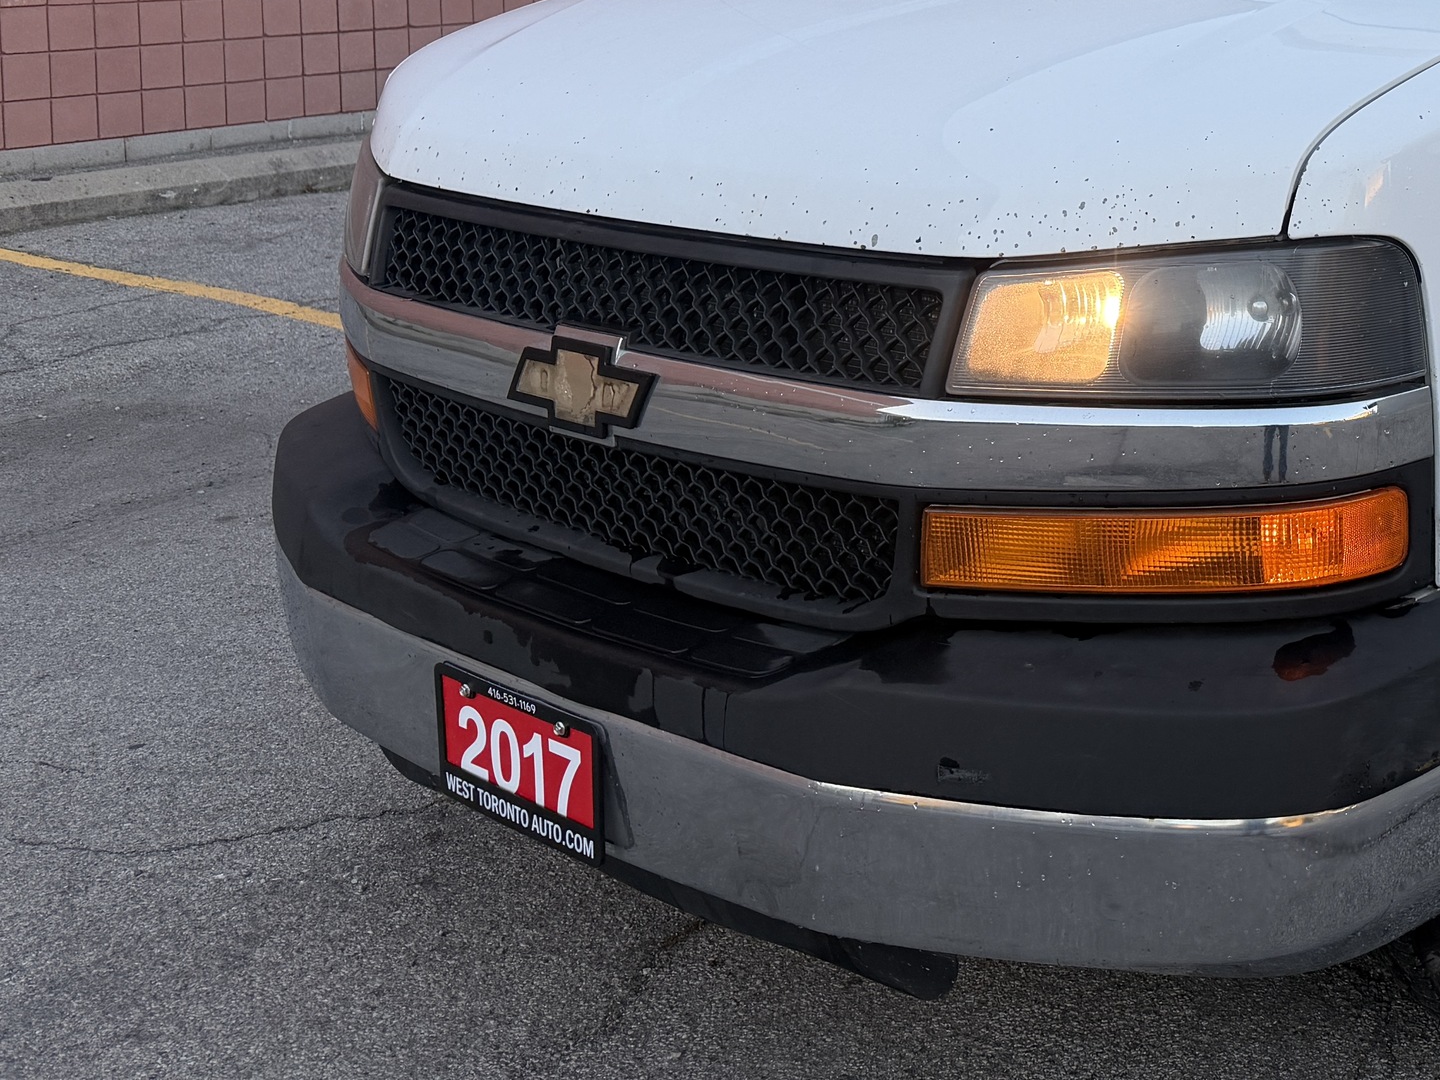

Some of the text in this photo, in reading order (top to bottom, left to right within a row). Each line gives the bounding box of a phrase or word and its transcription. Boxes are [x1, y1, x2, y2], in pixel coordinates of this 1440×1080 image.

[487, 686, 536, 714] 416-531-1169
[458, 705, 581, 818] 2017
[445, 771, 595, 859] WEST TORONTO AUTO.COM
